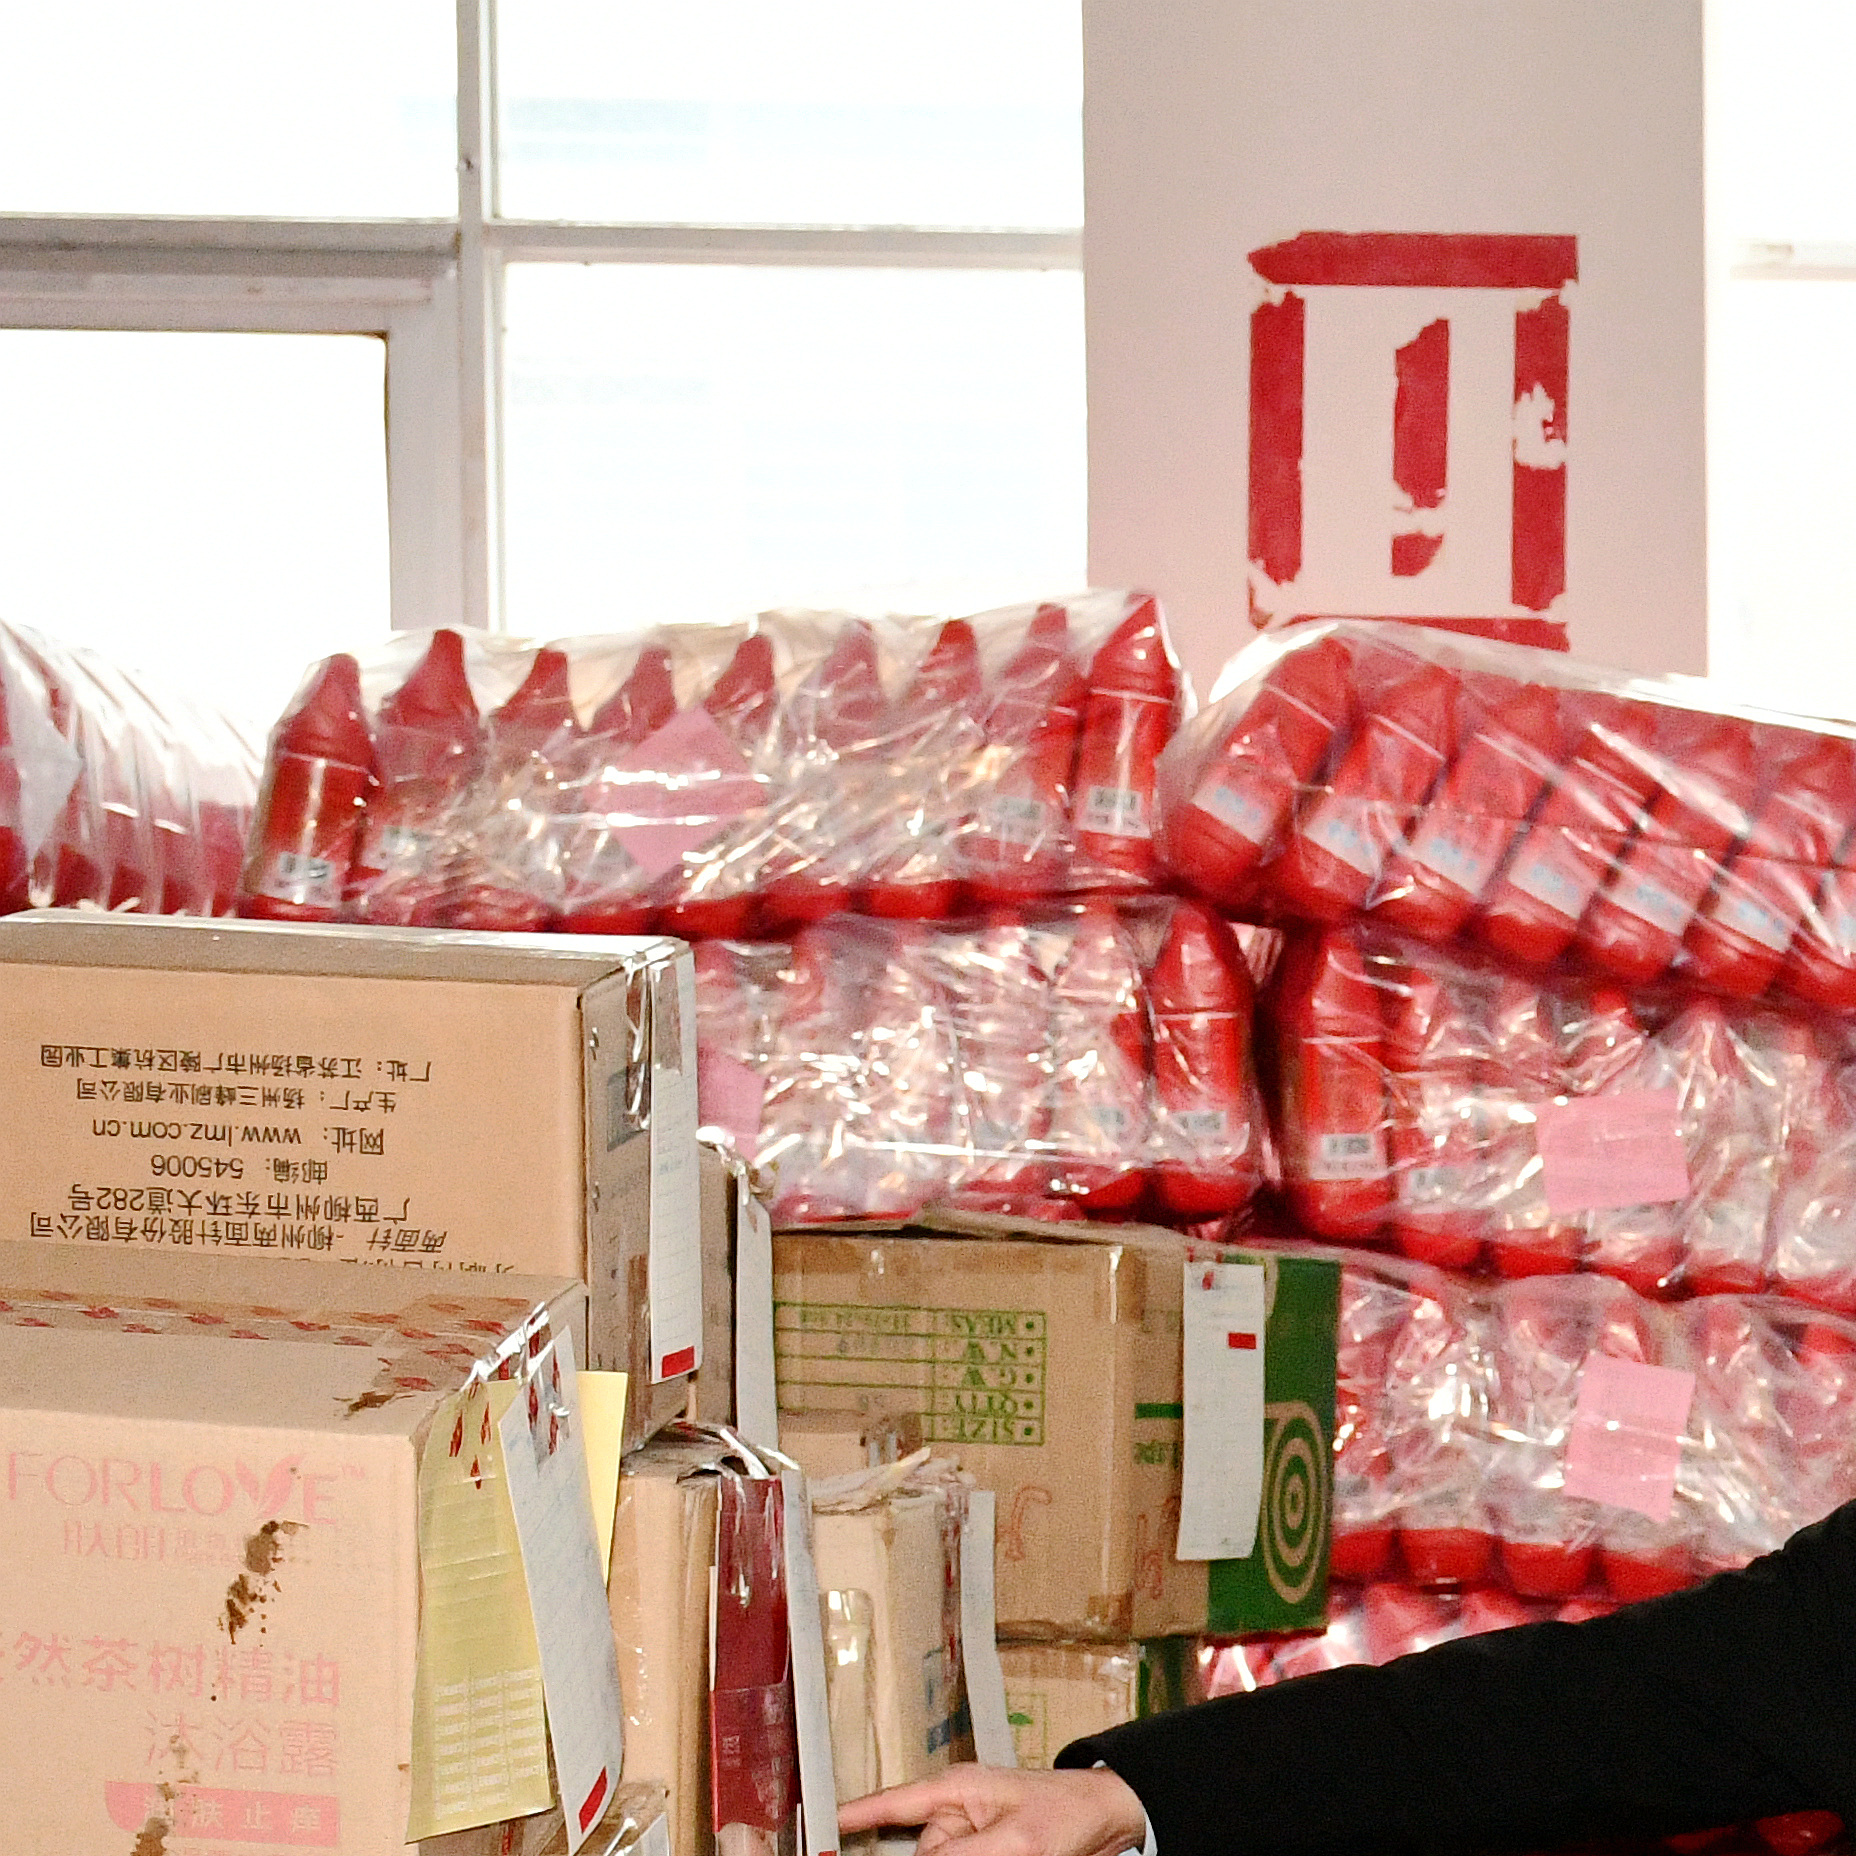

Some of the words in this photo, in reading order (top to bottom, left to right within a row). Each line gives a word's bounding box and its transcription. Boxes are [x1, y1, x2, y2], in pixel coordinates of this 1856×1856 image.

[151, 1155, 243, 1179] 545006
[0, 1630, 341, 1707] 然茶树精油
